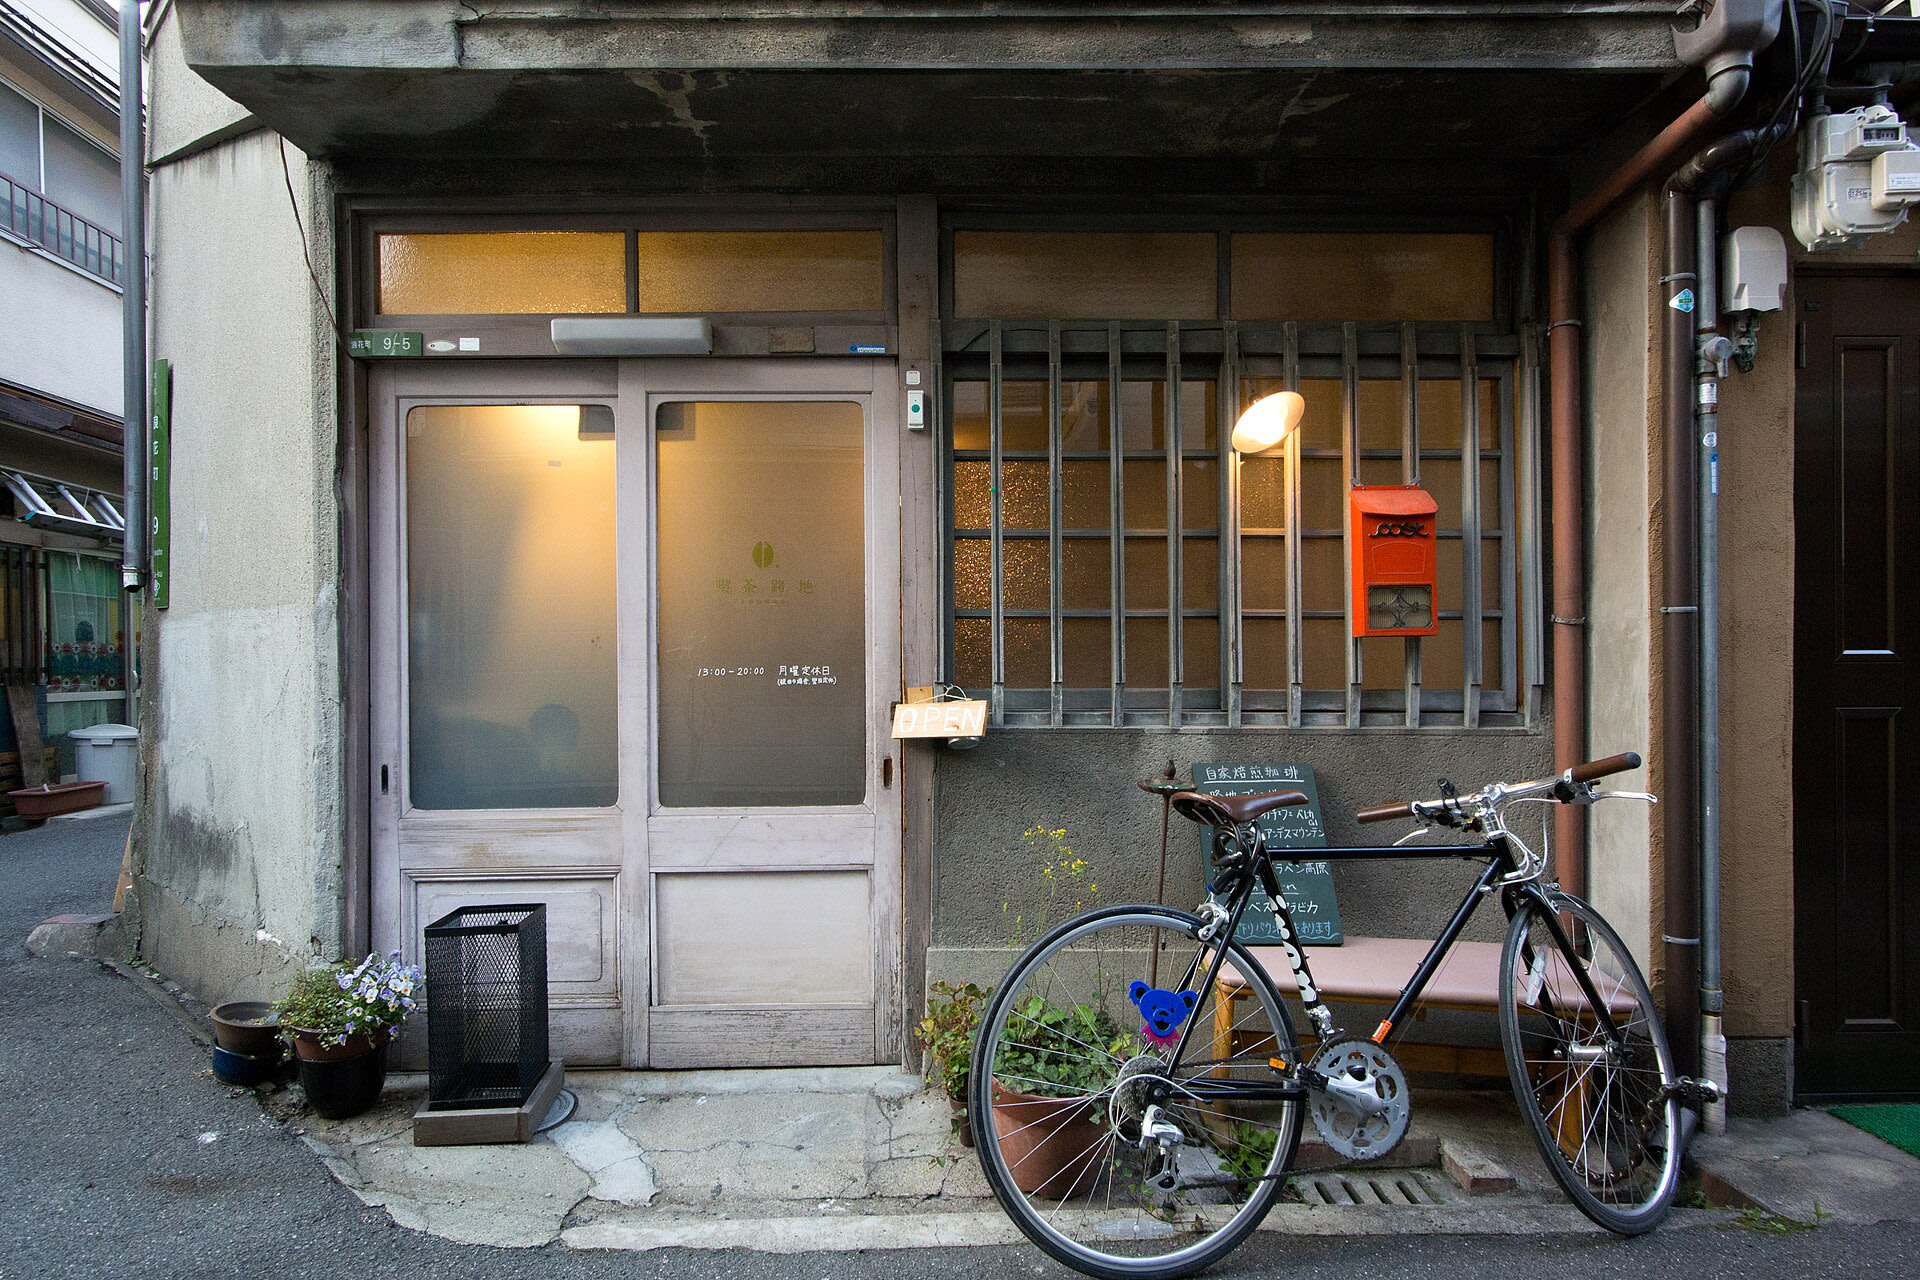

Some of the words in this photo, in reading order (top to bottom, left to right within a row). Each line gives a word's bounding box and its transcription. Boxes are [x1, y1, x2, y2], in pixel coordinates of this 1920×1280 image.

[383, 337, 411, 350] 9-5
[778, 665, 831, 677] 月曜定休日
[899, 704, 984, 733] OPEN
[1205, 765, 1299, 781] 自家焙煎珈琲
[1263, 826, 1325, 839] アンデスマウンテン
